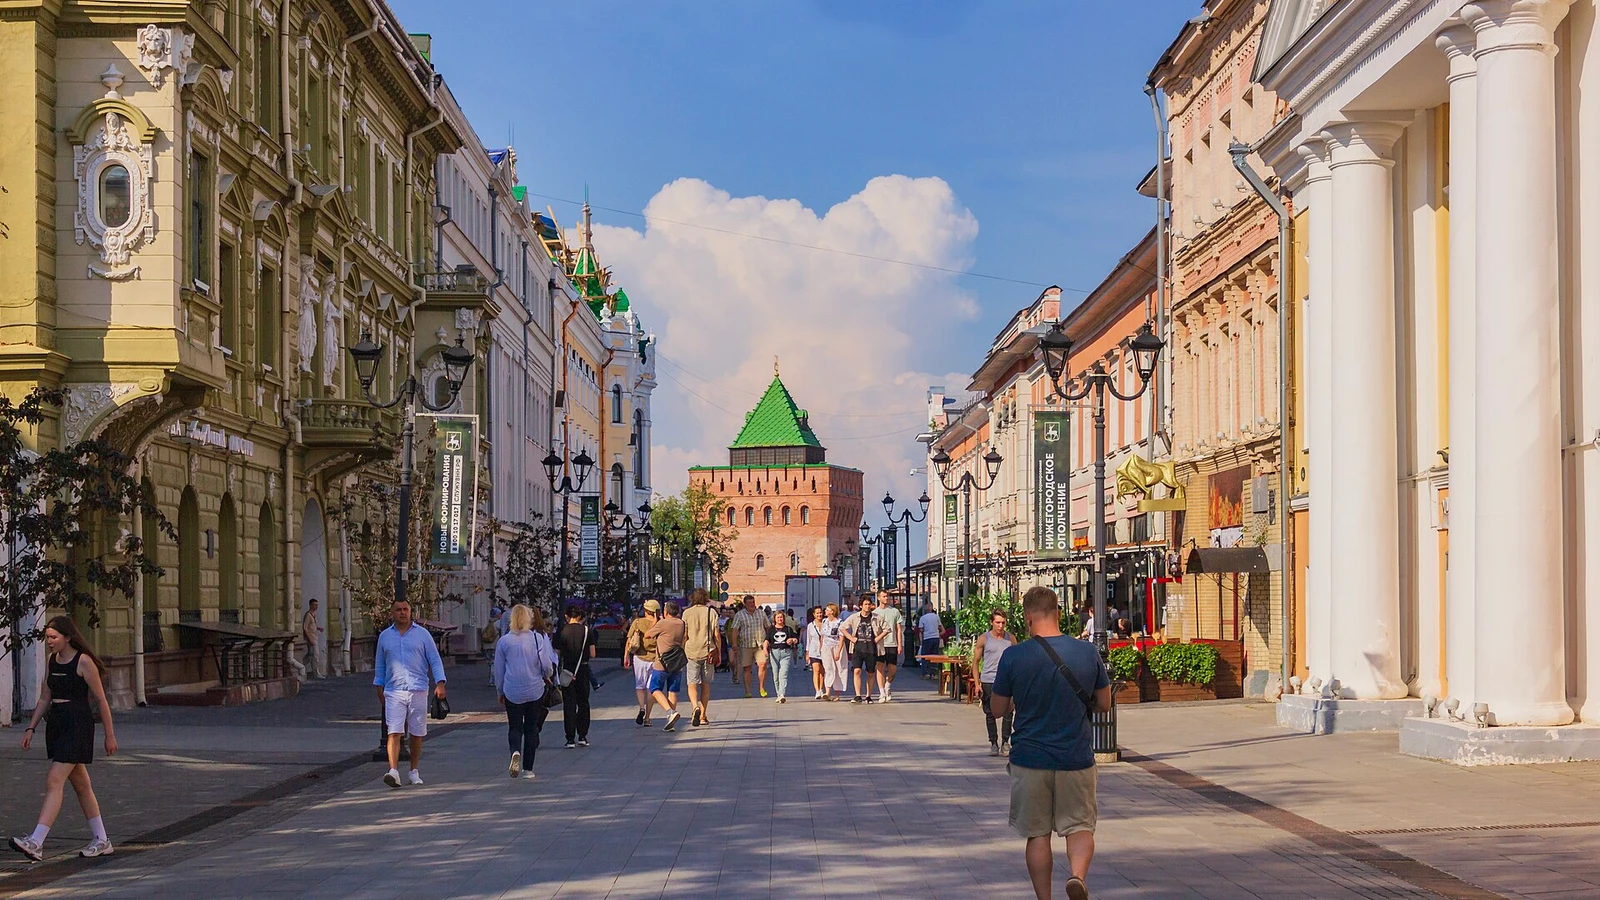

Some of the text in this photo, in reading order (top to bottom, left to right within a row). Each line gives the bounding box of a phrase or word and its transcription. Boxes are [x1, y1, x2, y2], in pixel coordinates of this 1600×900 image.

[440, 454, 450, 553] НОВЫЕ ФОРМИРОВАНИЯ
[1045, 453, 1055, 549] НИЖЕГОРОДСКОЕ
[1057, 482, 1066, 549] ОПОЛЧЕНИЕ
